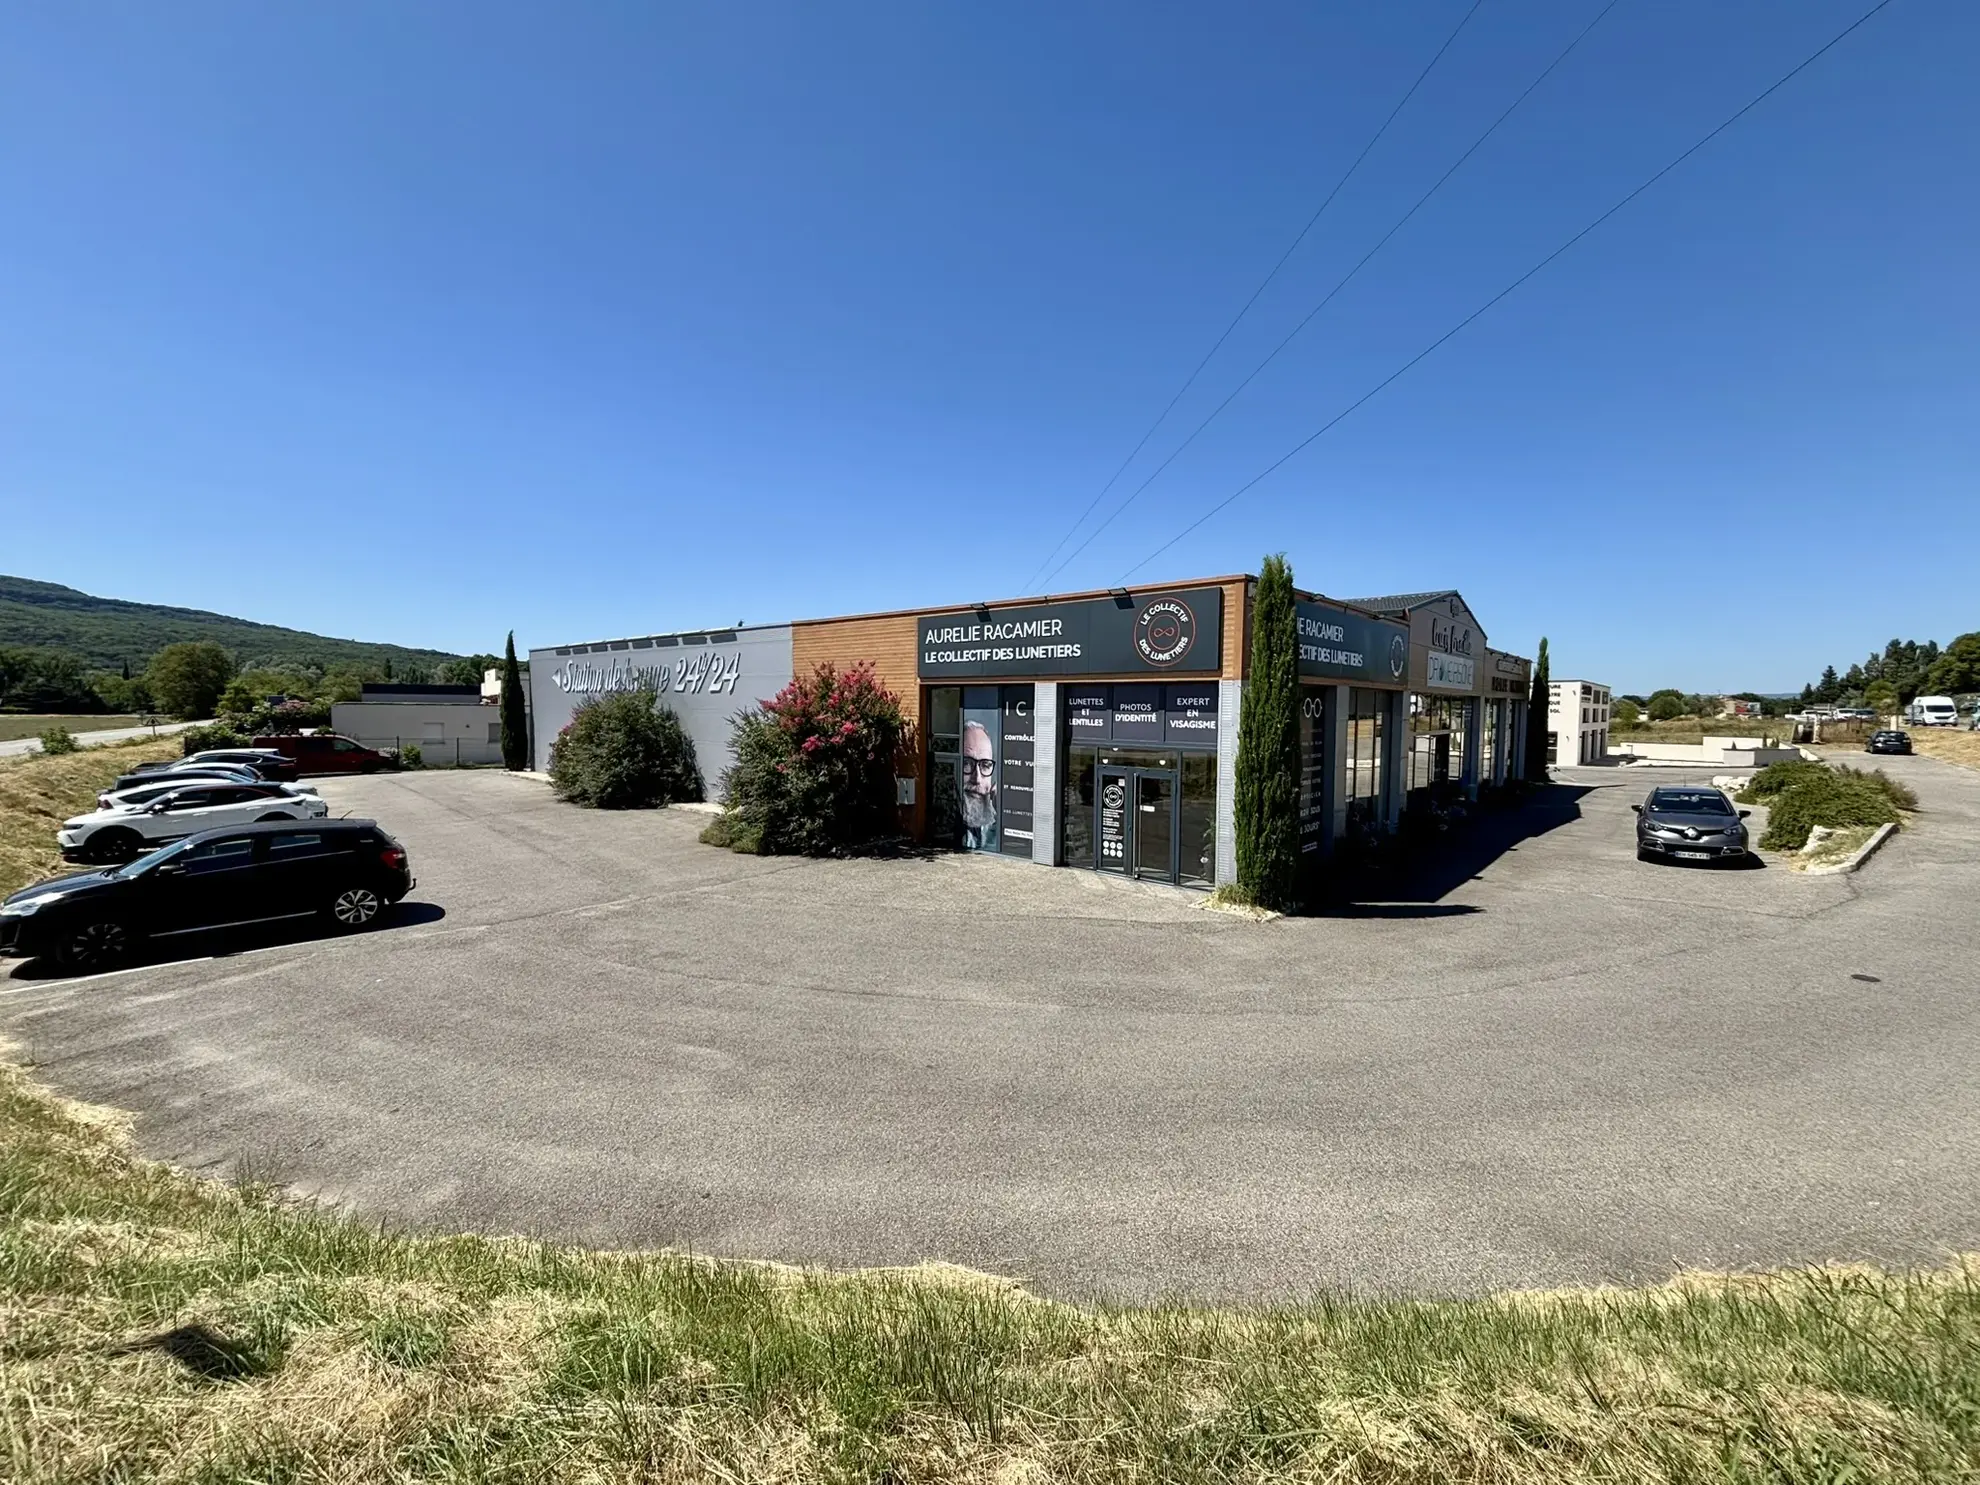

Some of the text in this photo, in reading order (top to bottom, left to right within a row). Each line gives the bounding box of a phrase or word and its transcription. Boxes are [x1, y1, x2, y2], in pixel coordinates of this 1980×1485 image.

[1140, 603, 1189, 625] LE COLLECTIF
[925, 619, 1063, 644] AURELIE RACAMIER
[1305, 619, 1344, 642] RACAMIER
[925, 644, 1082, 663] LE COLLECTIF DES LUNETIERS
[1139, 636, 1188, 661] DES LUNETIERS
[563, 659, 603, 694] Station
[605, 658, 622, 693] de
[1069, 698, 1104, 706] LUNETTES
[1120, 703, 1152, 711] PHOTOS
[1176, 697, 1210, 706] EXPERT
[1081, 708, 1091, 716] ET
[1186, 709, 1199, 717] EN
[1069, 718, 1104, 727] LENTILLES
